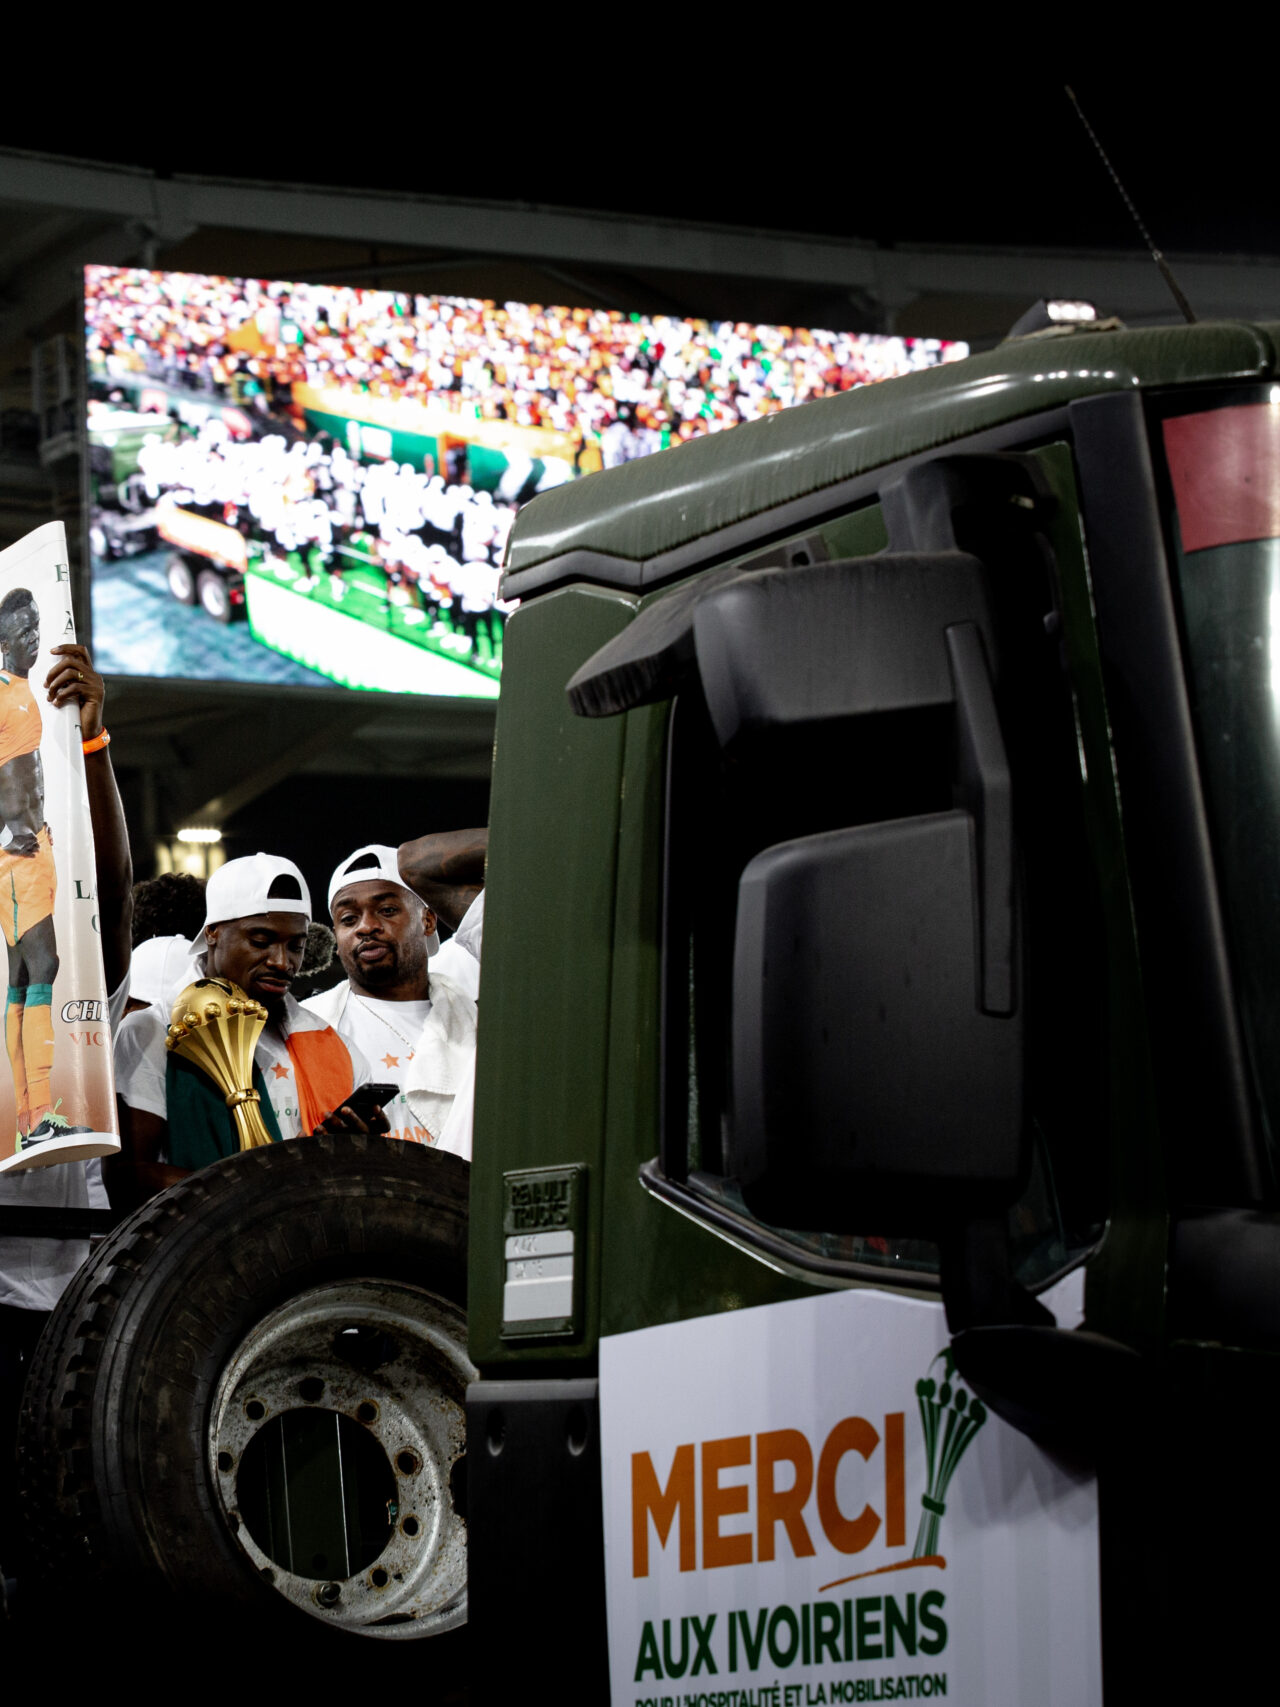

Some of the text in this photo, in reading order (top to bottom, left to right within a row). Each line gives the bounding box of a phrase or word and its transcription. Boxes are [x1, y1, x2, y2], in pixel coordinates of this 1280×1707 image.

[631, 1412, 906, 1578] MERCI
[634, 1590, 948, 1682] AUX IVOIRIENS
[784, 1684, 802, 1707] ET
[806, 1683, 827, 1705] LA
[830, 1672, 947, 1704] MOBILISATION
